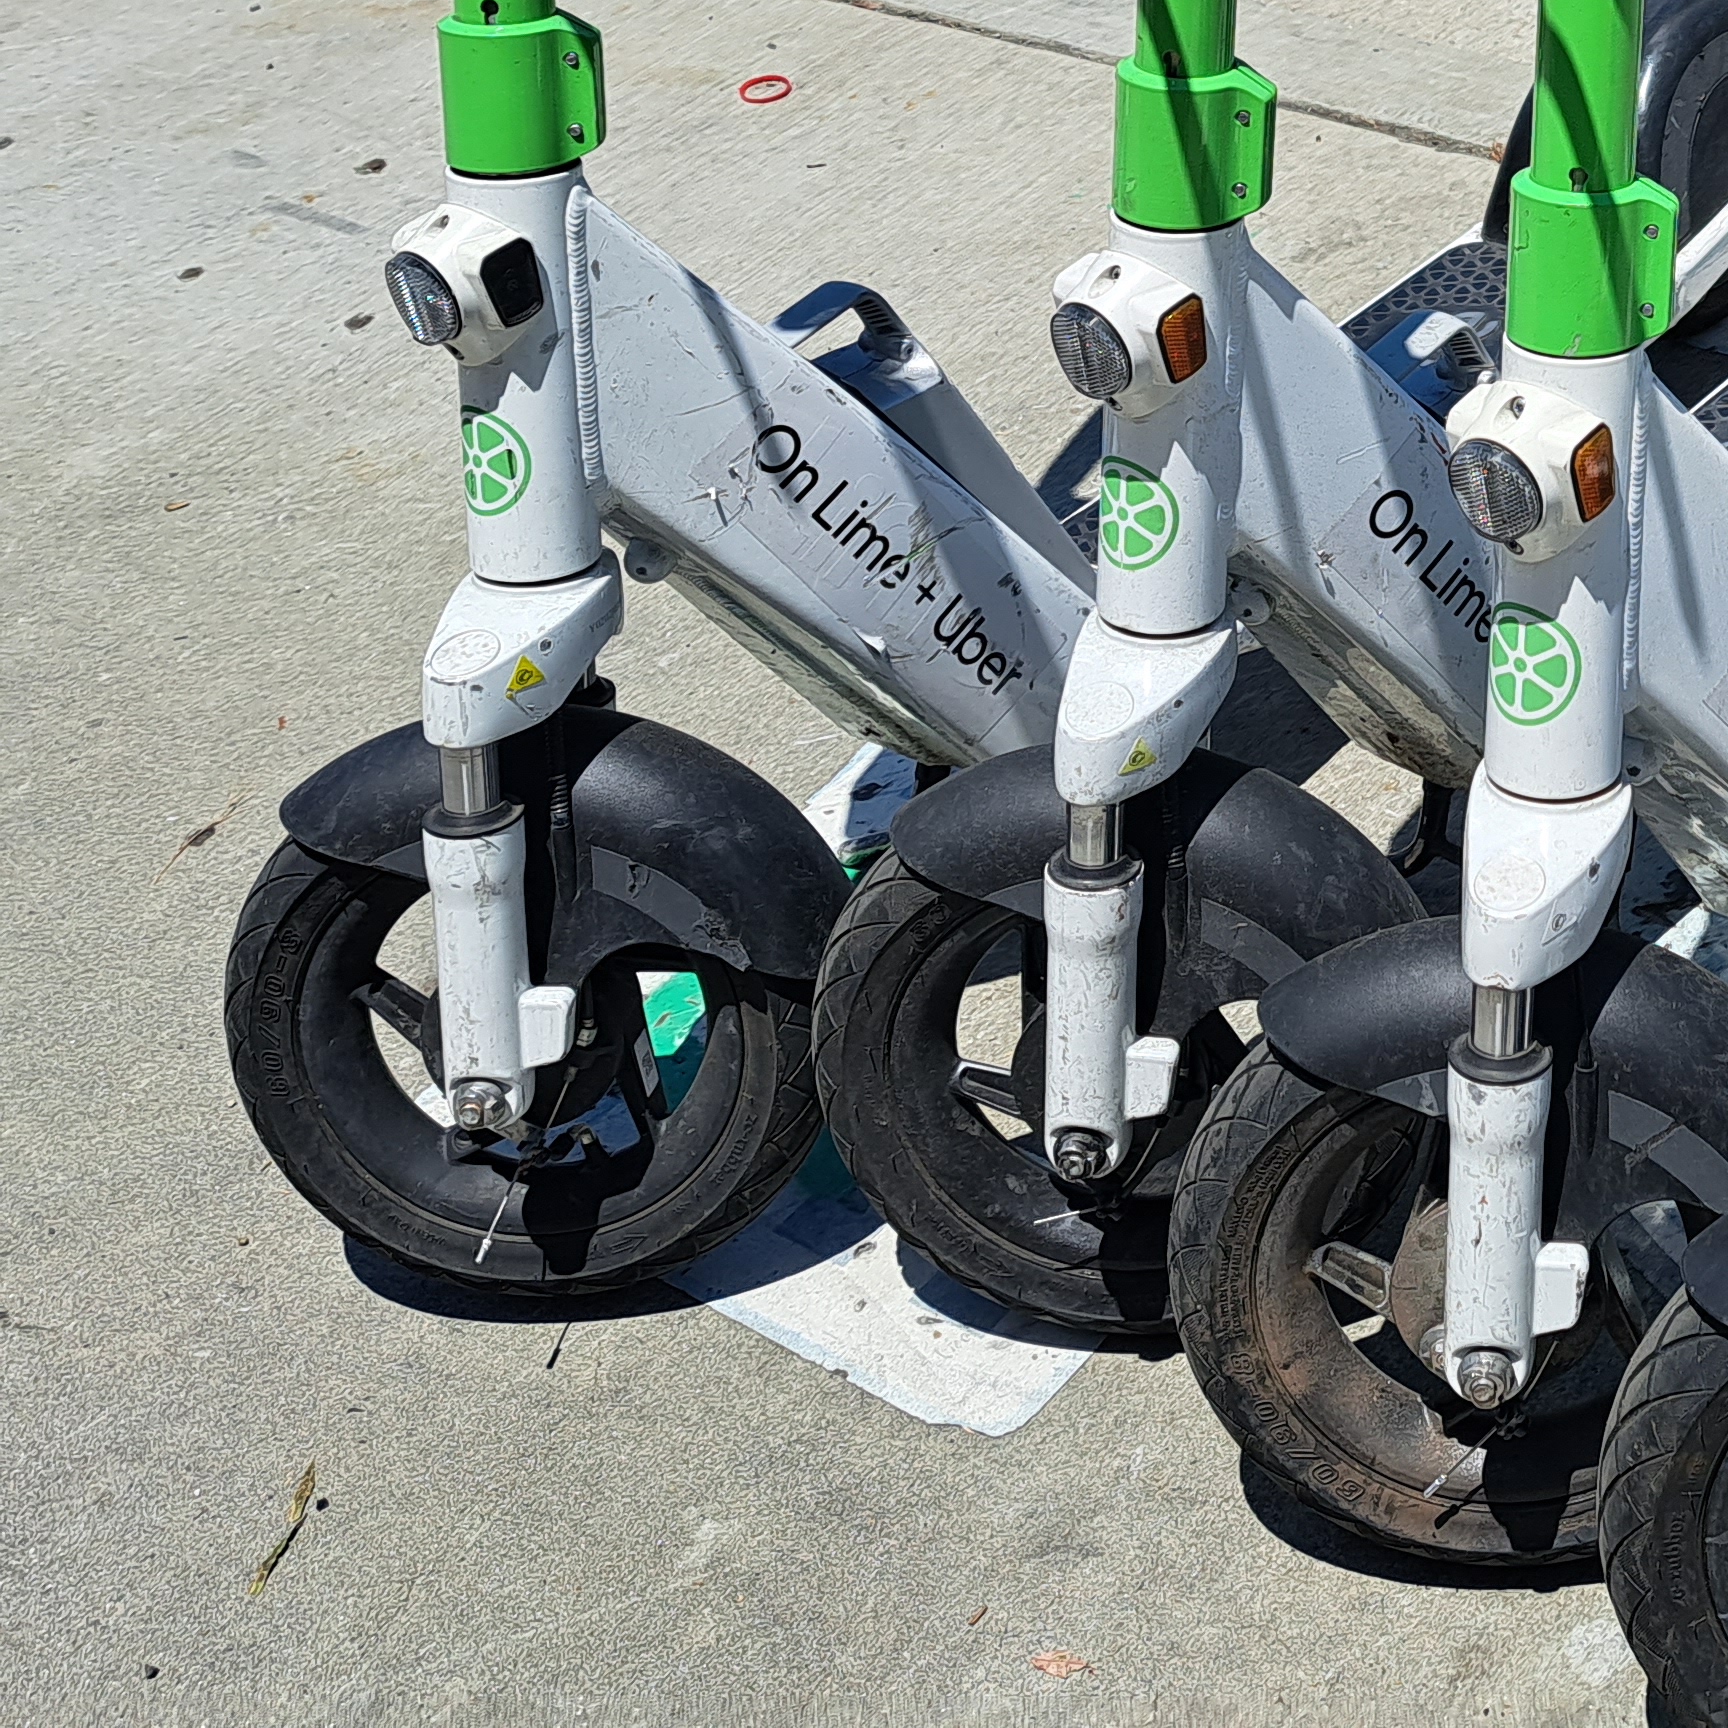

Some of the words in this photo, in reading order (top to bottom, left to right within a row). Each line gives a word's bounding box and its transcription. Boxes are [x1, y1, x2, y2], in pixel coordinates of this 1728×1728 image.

[752, 424, 820, 503] On
[811, 480, 912, 590] Lime
[915, 579, 939, 606] +
[932, 593, 1023, 696] Uber
[1369, 489, 1429, 568] On
